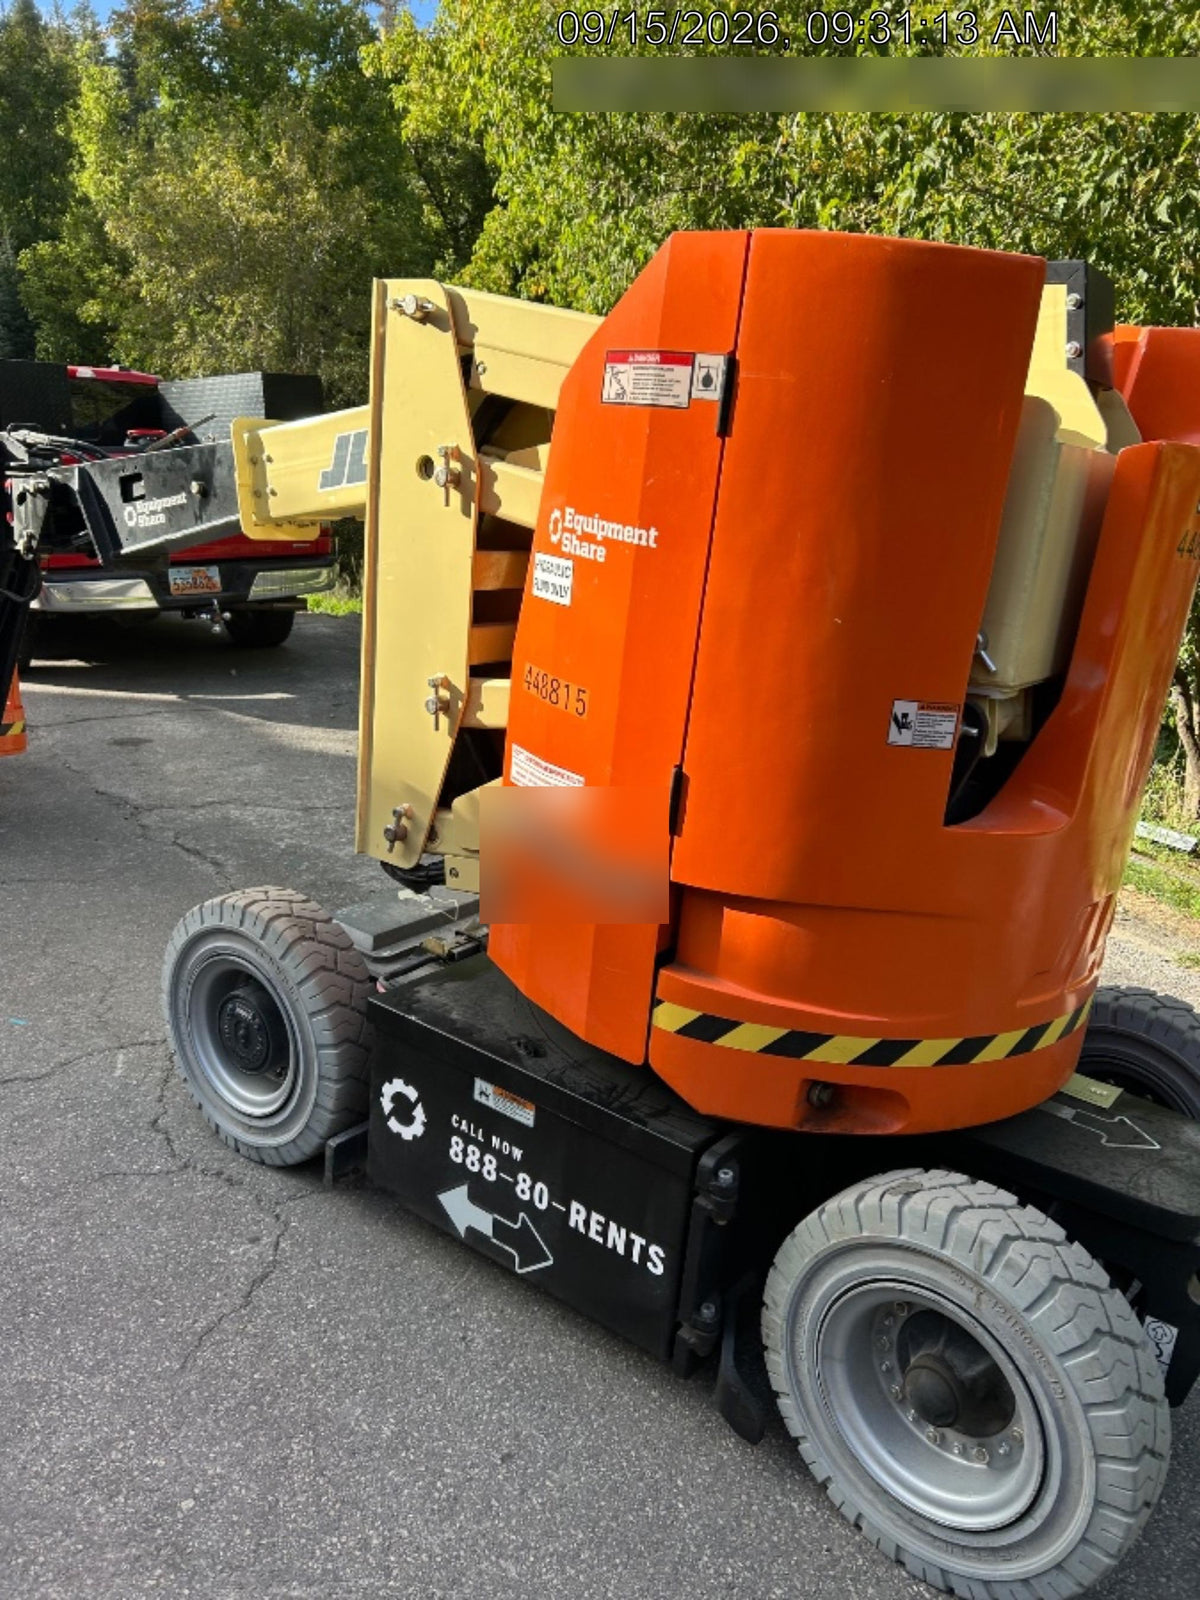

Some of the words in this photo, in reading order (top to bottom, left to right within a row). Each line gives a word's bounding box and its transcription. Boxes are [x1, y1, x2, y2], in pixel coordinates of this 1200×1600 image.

[318, 428, 369, 492] JL
[561, 532, 606, 562] Share
[564, 507, 658, 548] Equipment
[1176, 529, 1200, 560] 44
[524, 665, 587, 717] 448815
[450, 1113, 485, 1143] CALL
[491, 1134, 524, 1163] NOW
[449, 1136, 666, 1275] 888-80-RENTS
